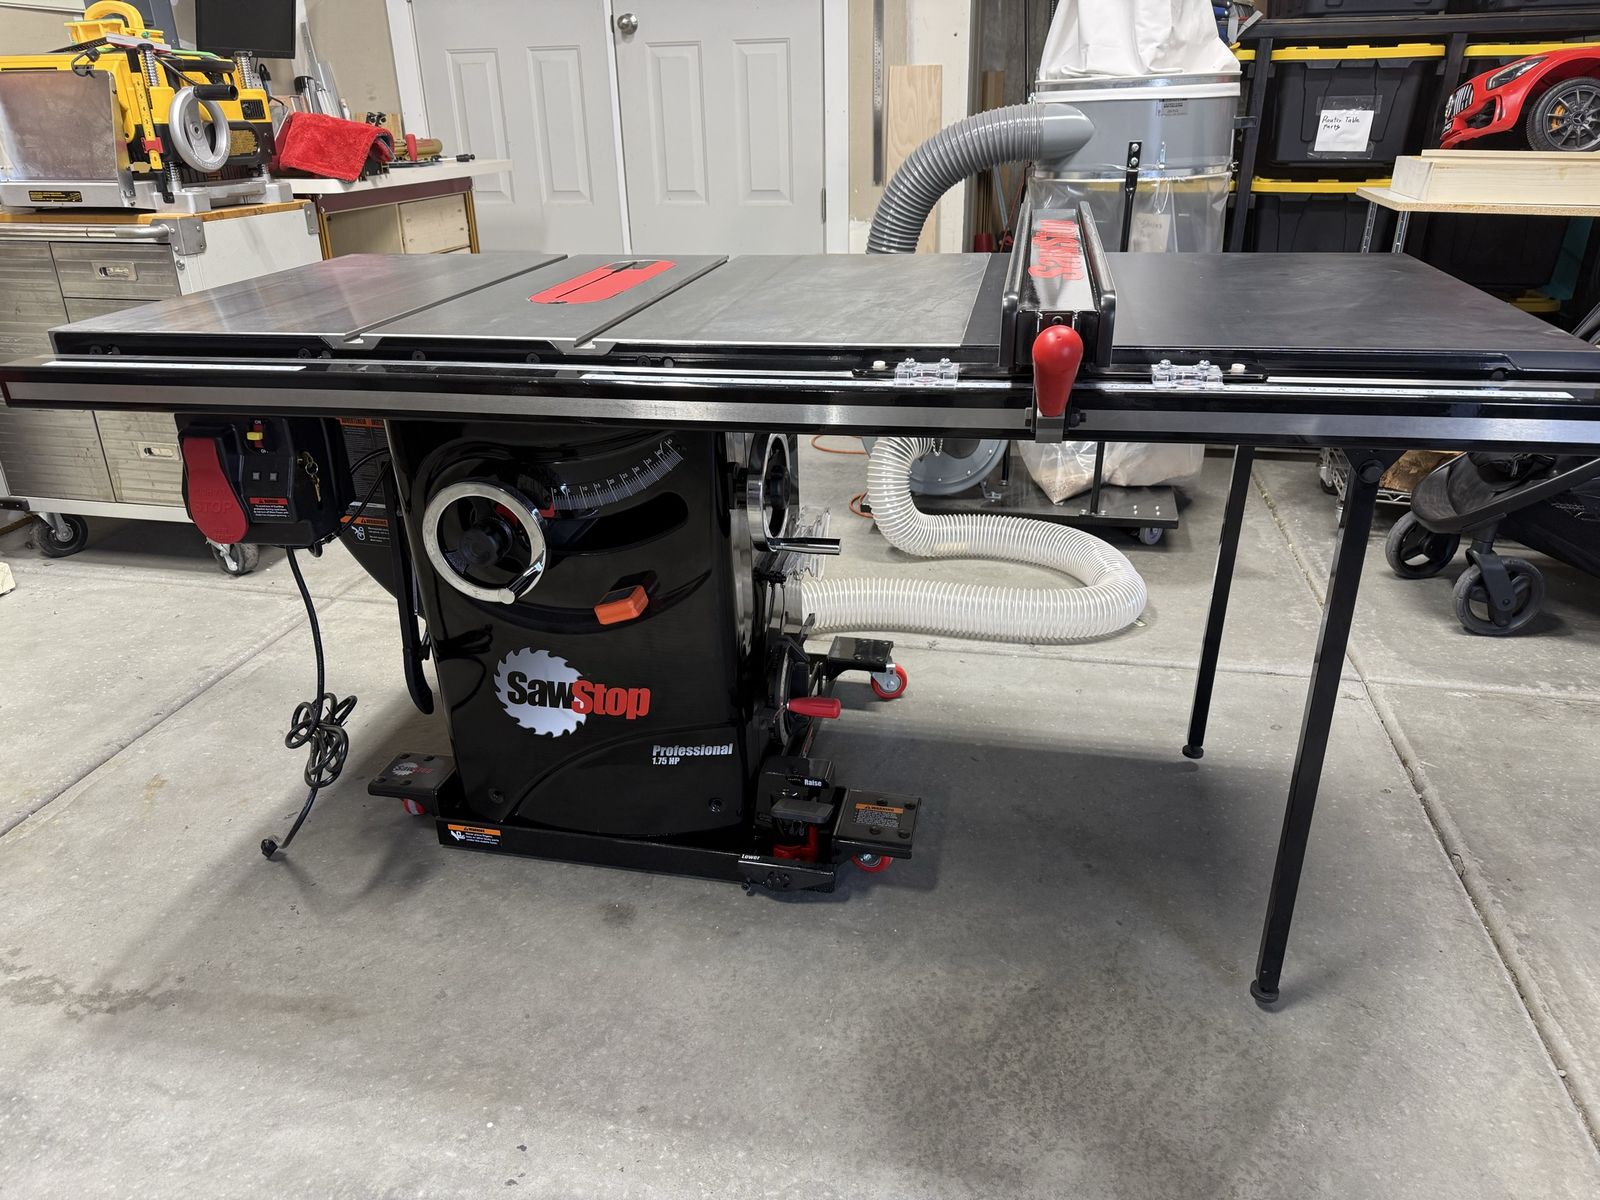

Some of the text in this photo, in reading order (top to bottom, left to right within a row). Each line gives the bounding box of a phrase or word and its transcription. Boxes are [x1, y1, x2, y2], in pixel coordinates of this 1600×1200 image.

[1345, 116, 1361, 124] Table
[507, 671, 651, 720] SawStop
[652, 743, 734, 757] Professional
[652, 756, 681, 765] 1.75 HP
[804, 778, 822, 787] Raise
[741, 853, 761, 861] Lower
